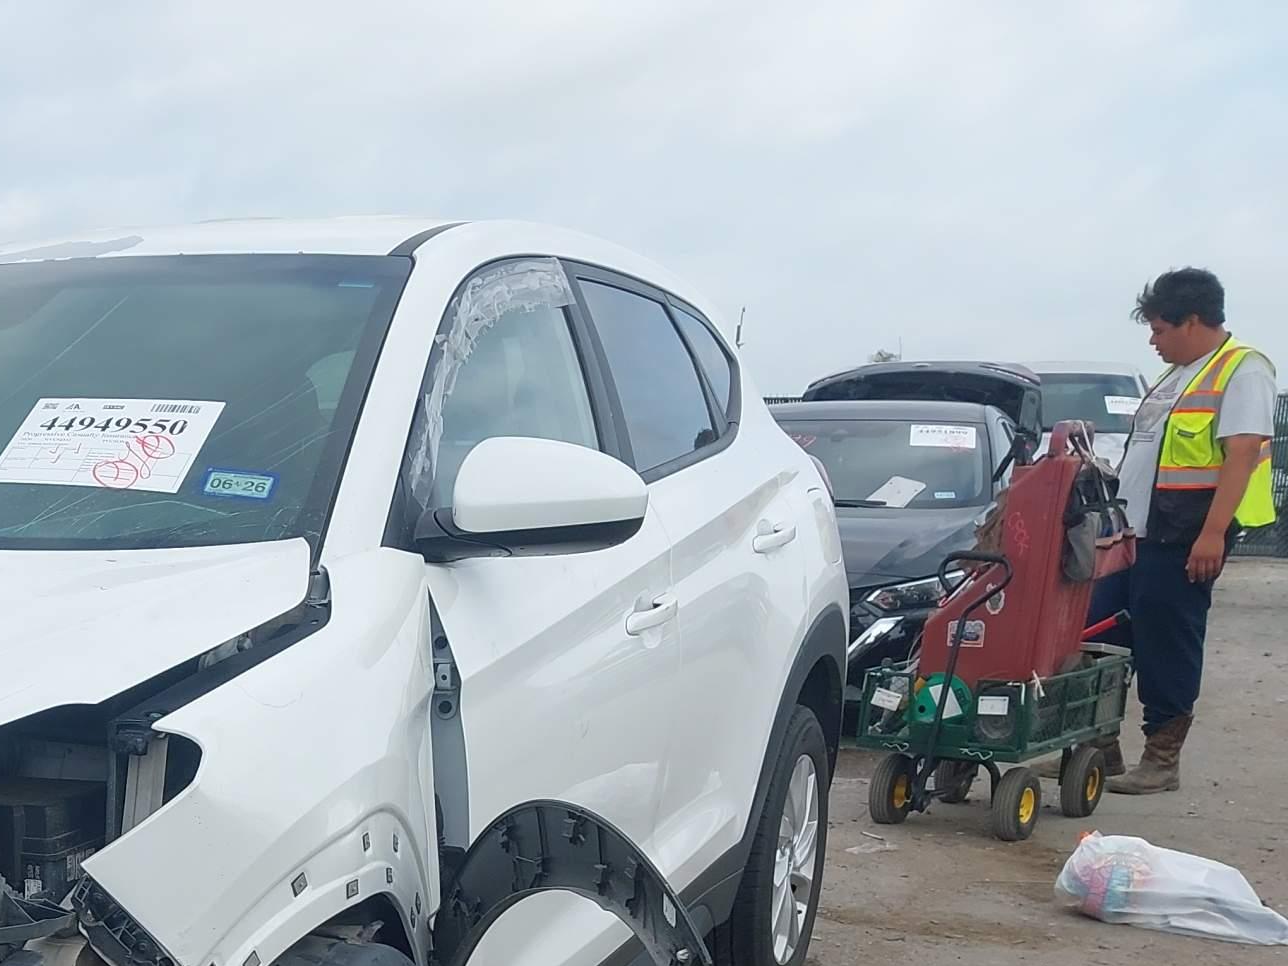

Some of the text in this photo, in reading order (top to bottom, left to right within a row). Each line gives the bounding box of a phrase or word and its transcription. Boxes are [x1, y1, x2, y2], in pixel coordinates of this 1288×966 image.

[39, 416, 188, 435] 44949550
[210, 478, 267, 493] 06 26
